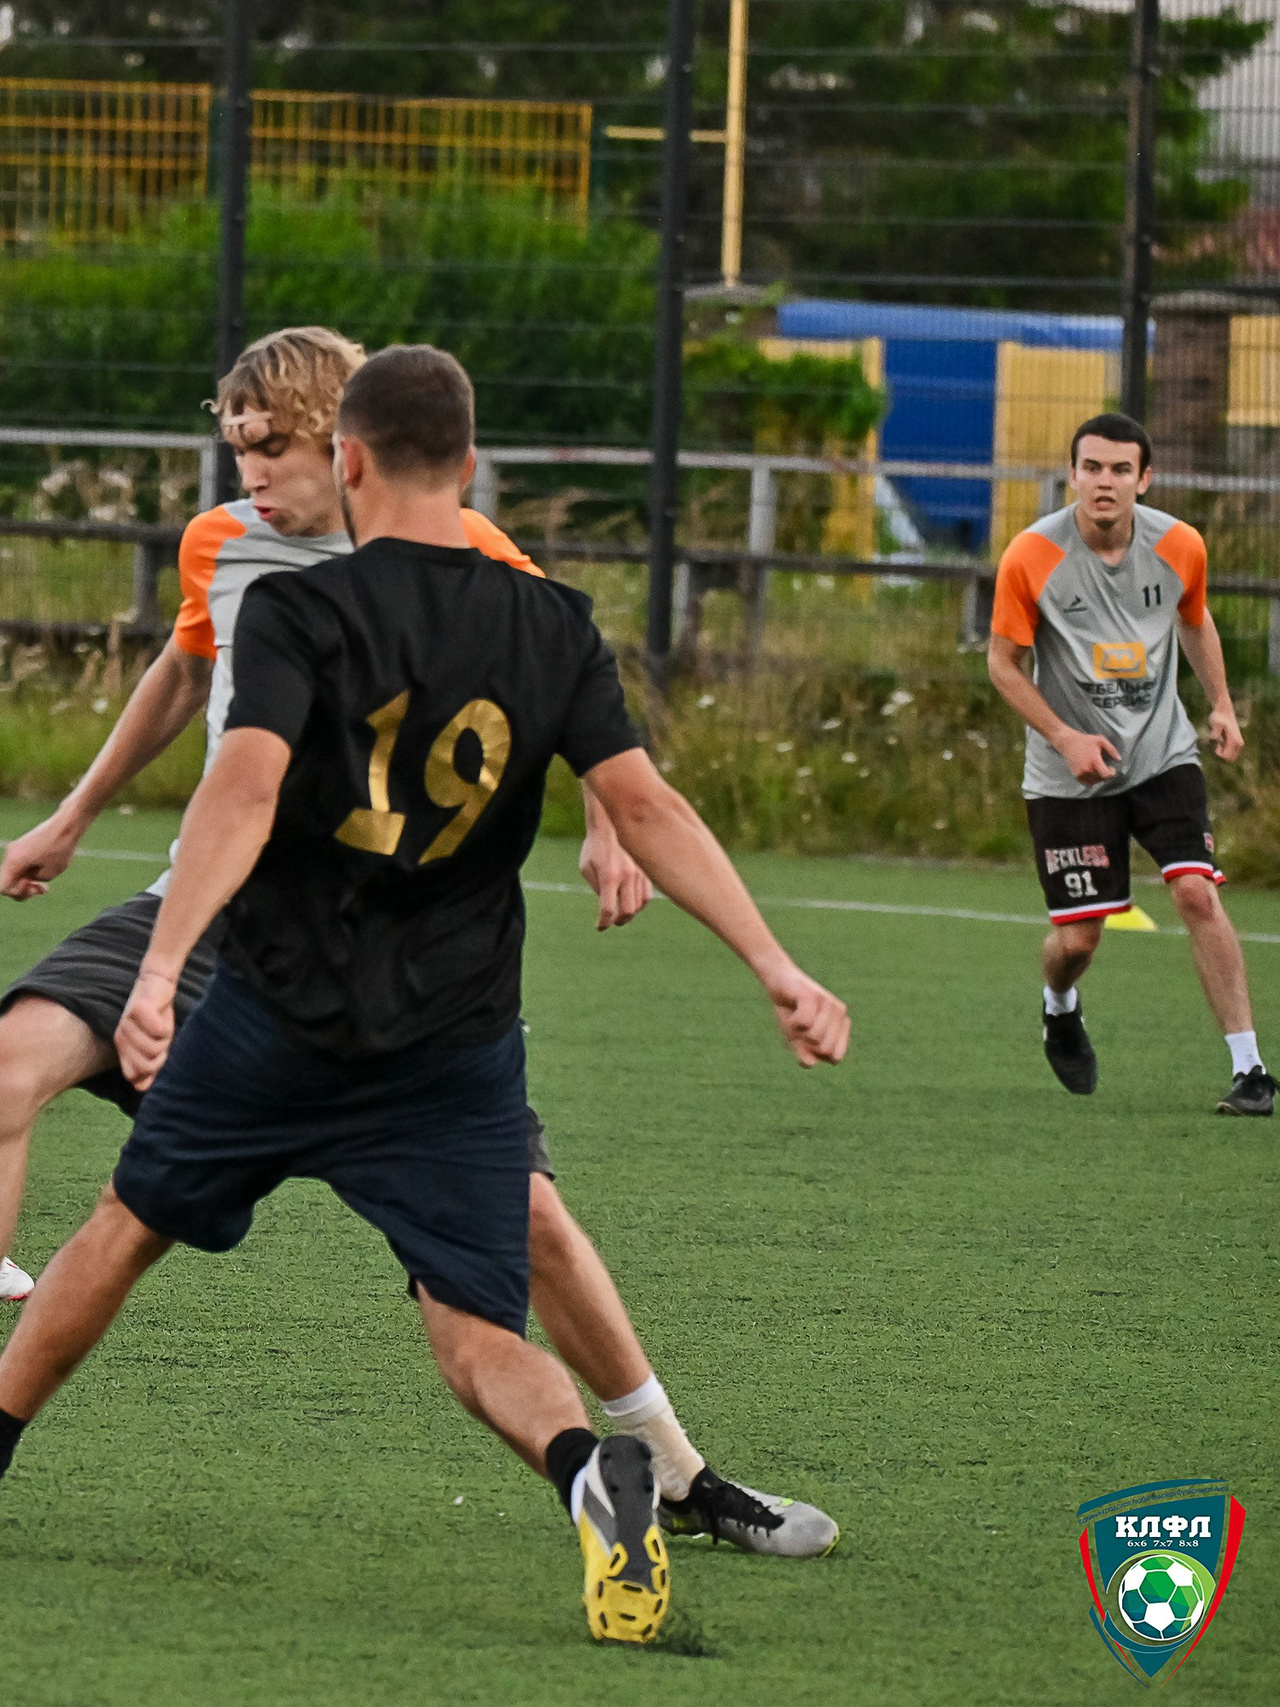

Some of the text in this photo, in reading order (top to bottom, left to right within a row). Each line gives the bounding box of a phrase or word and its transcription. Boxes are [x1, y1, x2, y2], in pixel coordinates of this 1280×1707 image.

[1141, 583, 1162, 608] 11
[333, 688, 512, 866] 19
[1064, 870, 1099, 899] 91
